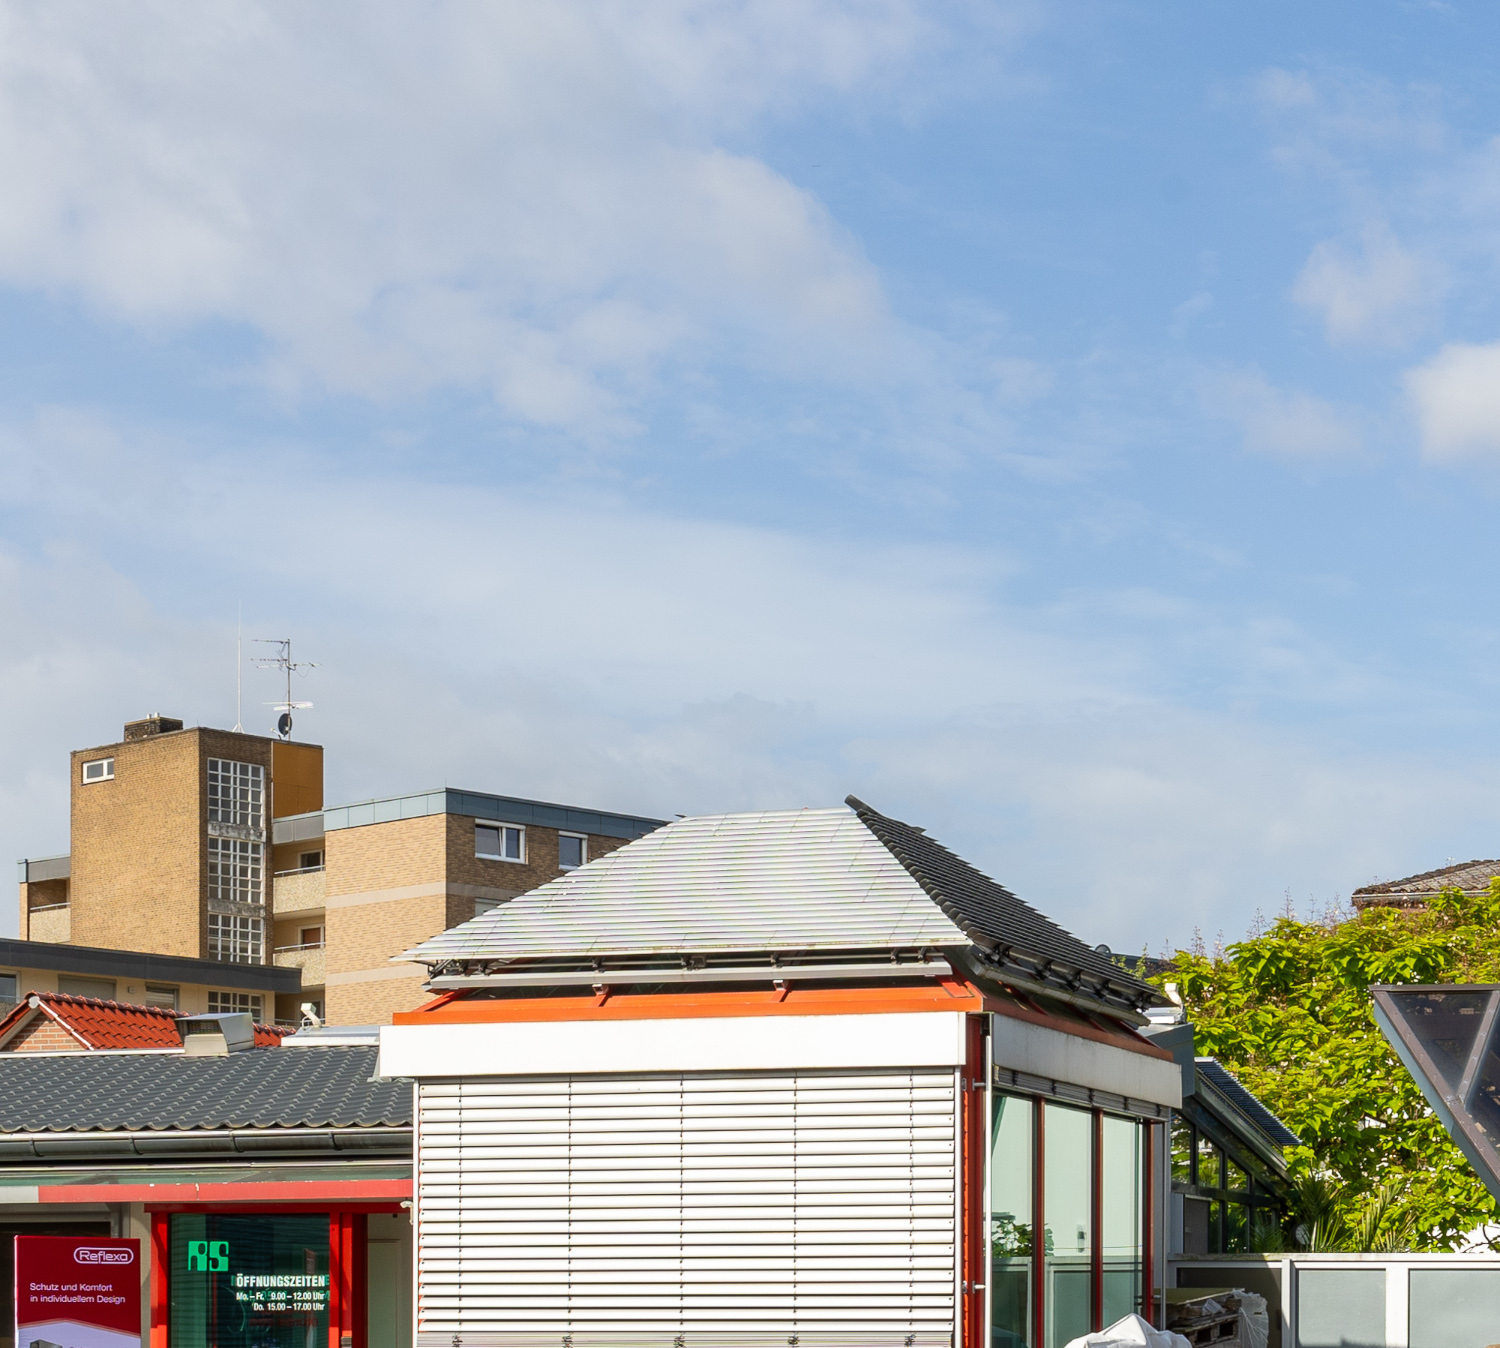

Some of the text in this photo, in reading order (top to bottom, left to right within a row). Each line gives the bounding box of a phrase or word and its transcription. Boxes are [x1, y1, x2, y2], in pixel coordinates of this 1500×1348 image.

[79, 1251, 128, 1263] Reflexa
[236, 1273, 325, 1287] ÖFFNUNGSZEITEN
[30, 1283, 59, 1291] Schutz
[80, 1283, 113, 1291] Komfort
[40, 1295, 94, 1303] individuellem
[97, 1295, 126, 1305] Design
[271, 1292, 286, 1300] 9.00
[293, 1292, 312, 1300] 12.00
[312, 1292, 325, 1300] Uhr
[253, 1303, 265, 1311] Do.
[267, 1303, 286, 1311] 15.00
[293, 1303, 312, 1311] 17.00
[312, 1303, 325, 1311] Uhr
